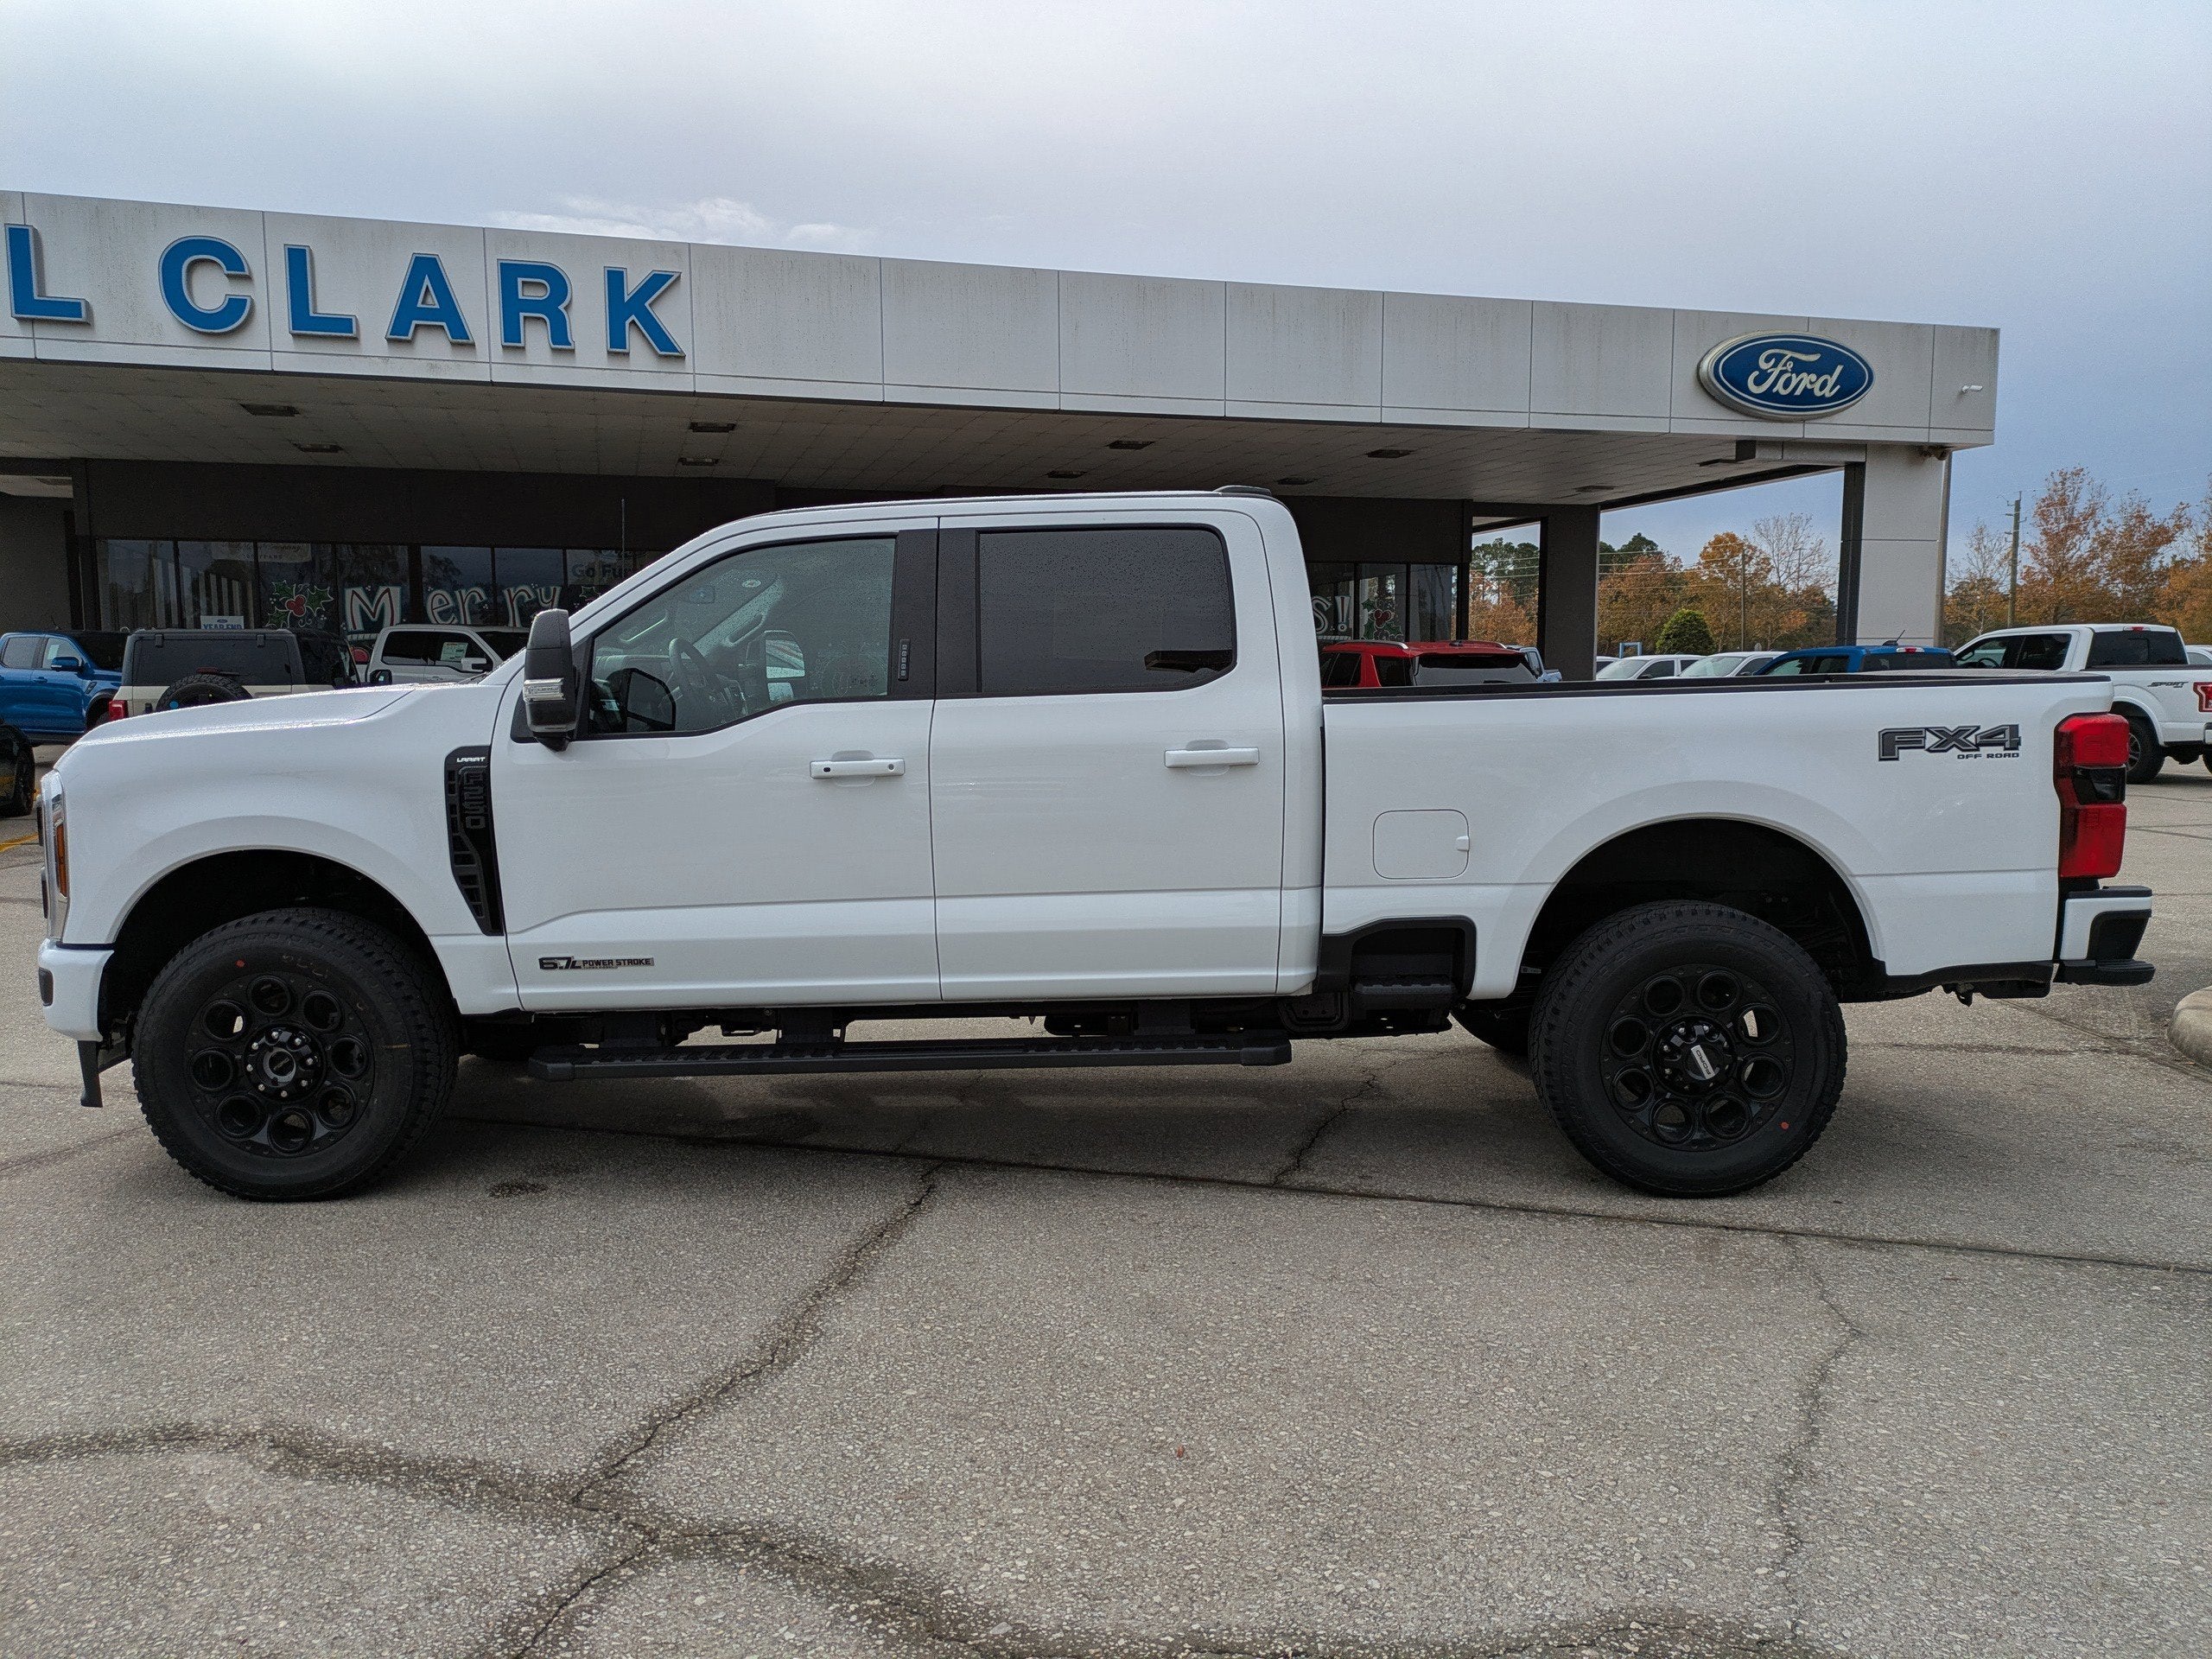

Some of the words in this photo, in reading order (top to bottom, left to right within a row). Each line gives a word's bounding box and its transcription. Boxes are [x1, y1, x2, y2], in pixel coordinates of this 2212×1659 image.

[158, 234, 687, 358] CLARK
[1747, 348, 1844, 397] Ford
[345, 586, 562, 632] Merry
[1878, 724, 2022, 761] FX4
[537, 956, 582, 969] 6.7L
[582, 958, 614, 968] POWER
[614, 957, 652, 967] STROKE
